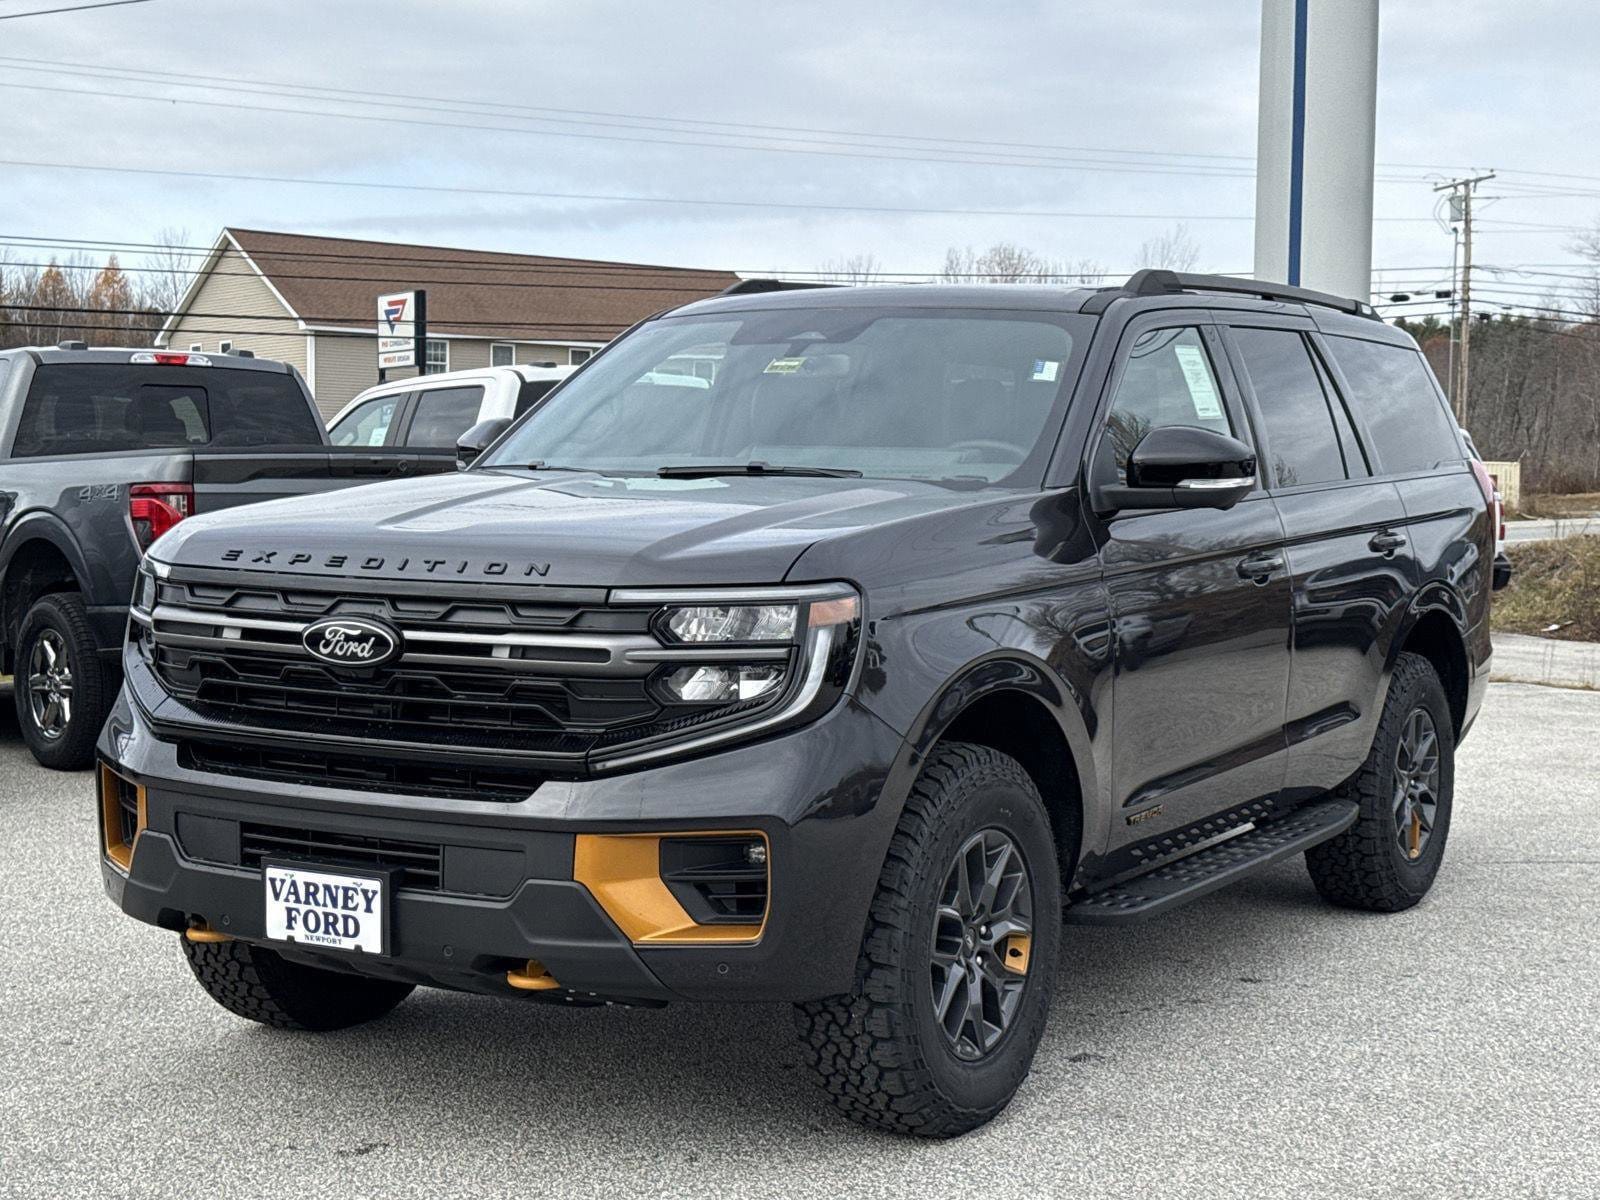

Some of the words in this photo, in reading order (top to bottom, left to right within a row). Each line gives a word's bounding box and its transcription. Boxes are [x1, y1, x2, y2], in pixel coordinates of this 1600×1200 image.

[221, 548, 552, 577] EXPEDITION
[318, 626, 375, 658] Ford
[268, 876, 379, 914] VARNEY
[285, 906, 361, 939] FORD
[304, 934, 343, 945] NEWPORT
